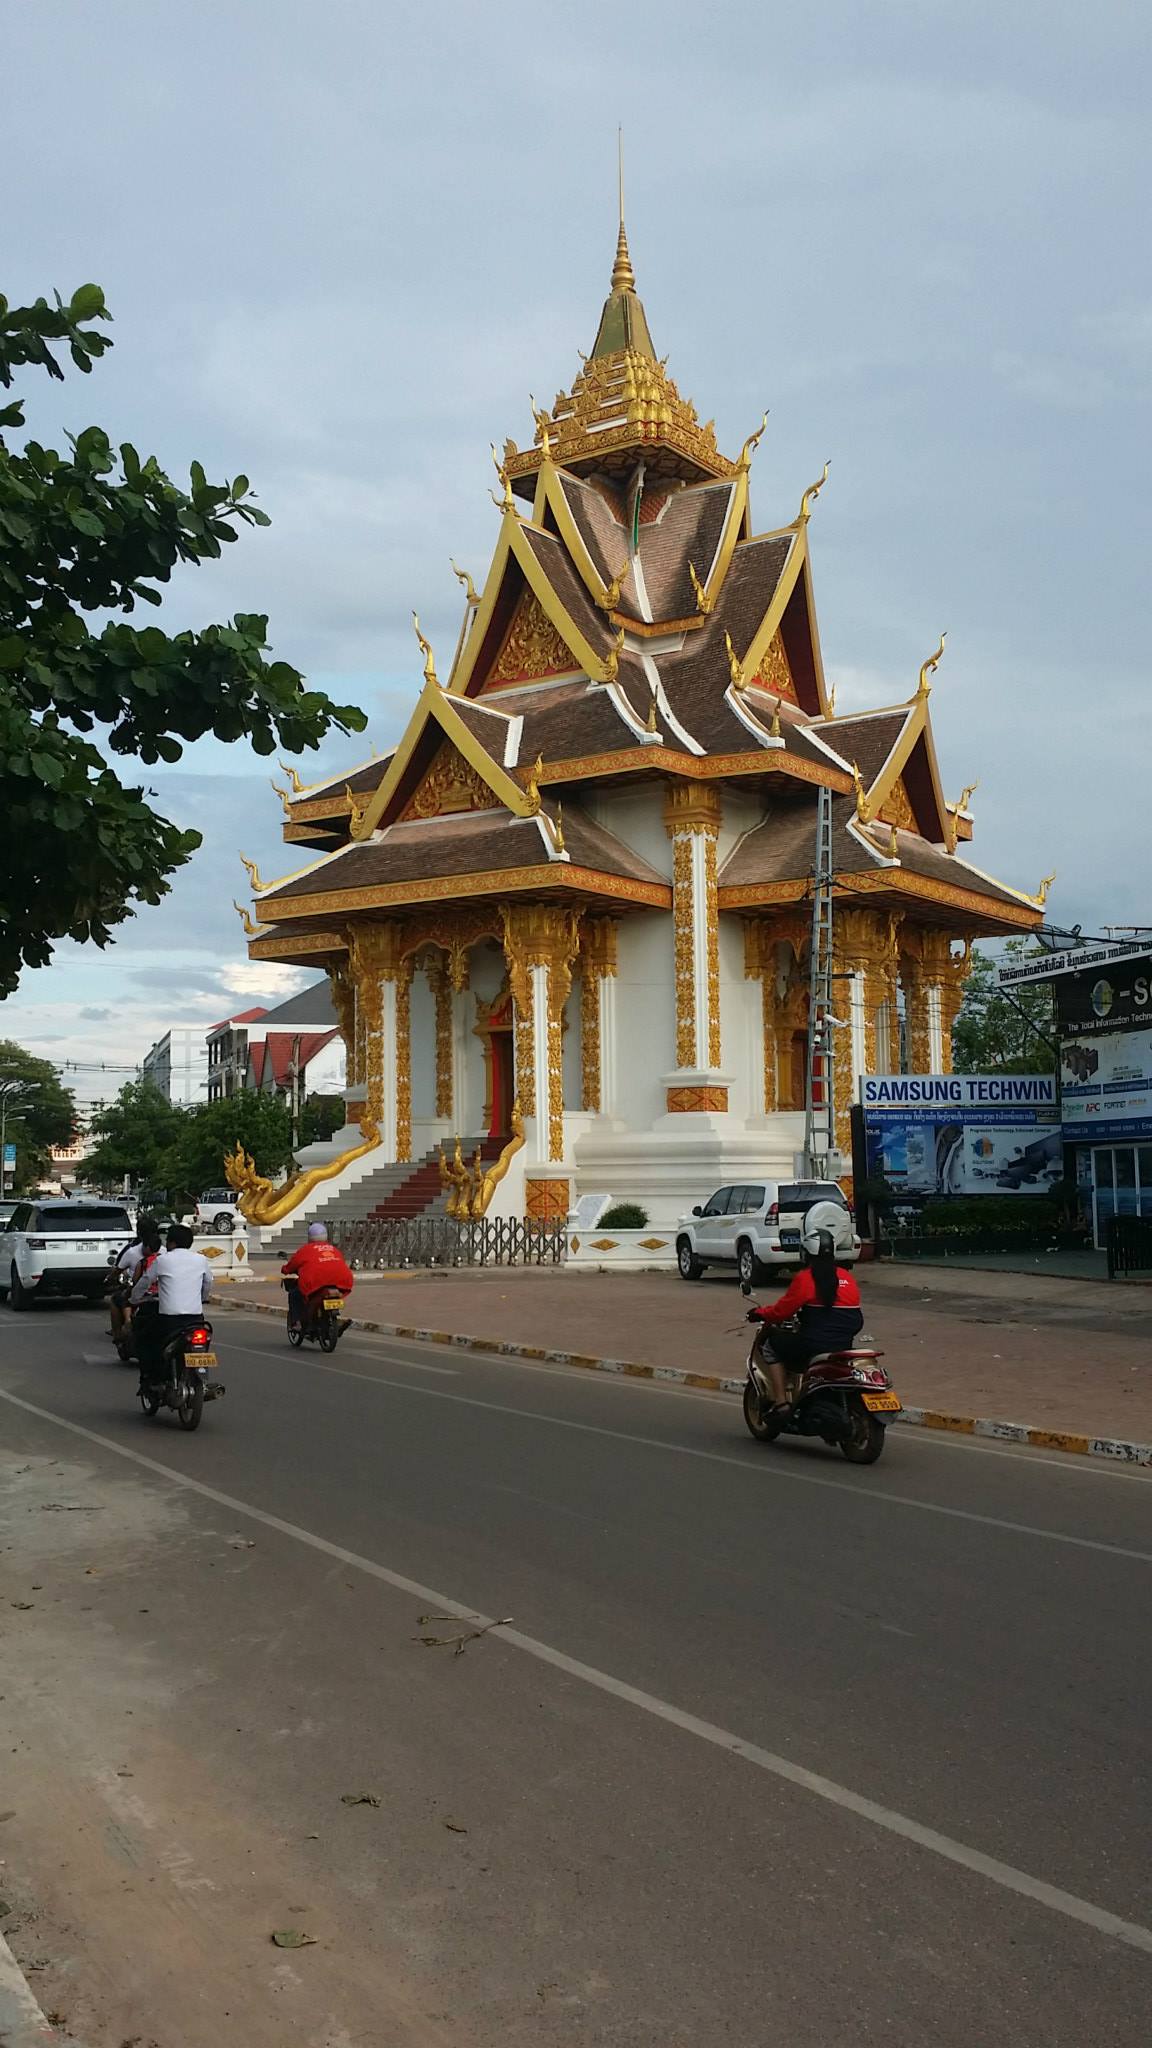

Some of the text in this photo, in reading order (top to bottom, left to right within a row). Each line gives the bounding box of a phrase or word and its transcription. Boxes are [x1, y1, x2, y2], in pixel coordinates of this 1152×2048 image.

[1067, 1023, 1079, 1032] The
[1081, 1020, 1095, 1030] Total
[865, 1081, 961, 1101] SAMSUNG
[966, 1081, 1053, 1101] TECHWIN
